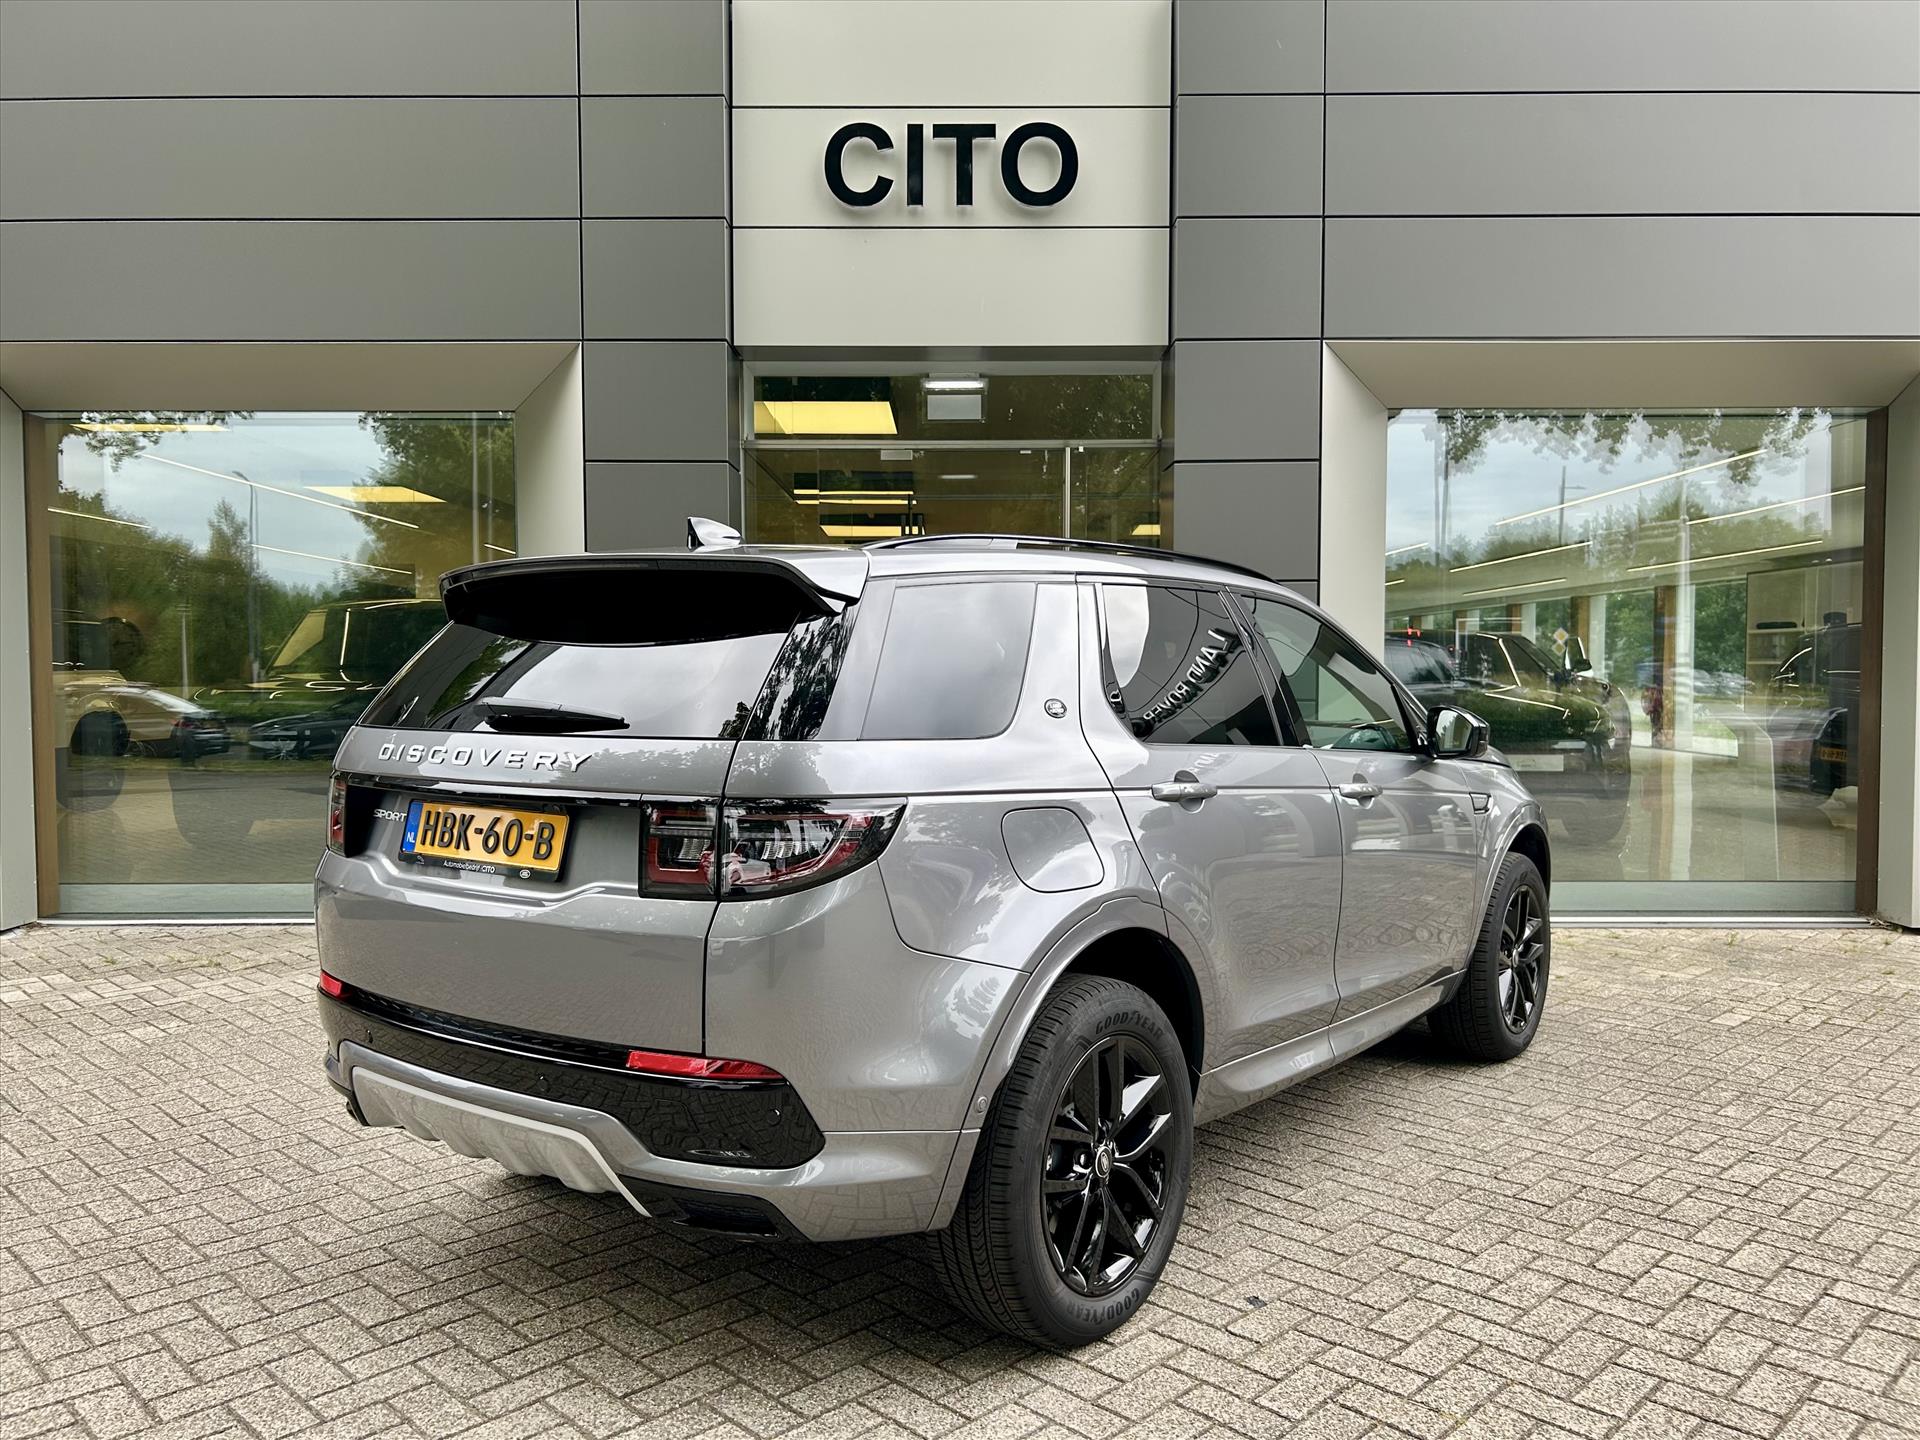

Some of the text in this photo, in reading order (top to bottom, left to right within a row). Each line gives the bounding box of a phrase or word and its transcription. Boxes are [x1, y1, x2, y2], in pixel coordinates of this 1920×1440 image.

[824, 122, 1079, 207] CITO
[378, 743, 593, 772] DISCOVERY
[373, 808, 407, 822] SPORT
[406, 832, 416, 843] NL
[420, 810, 555, 861] HBK-60-B
[481, 864, 496, 873] CITO
[1095, 1010, 1164, 1039] GOODYEAR
